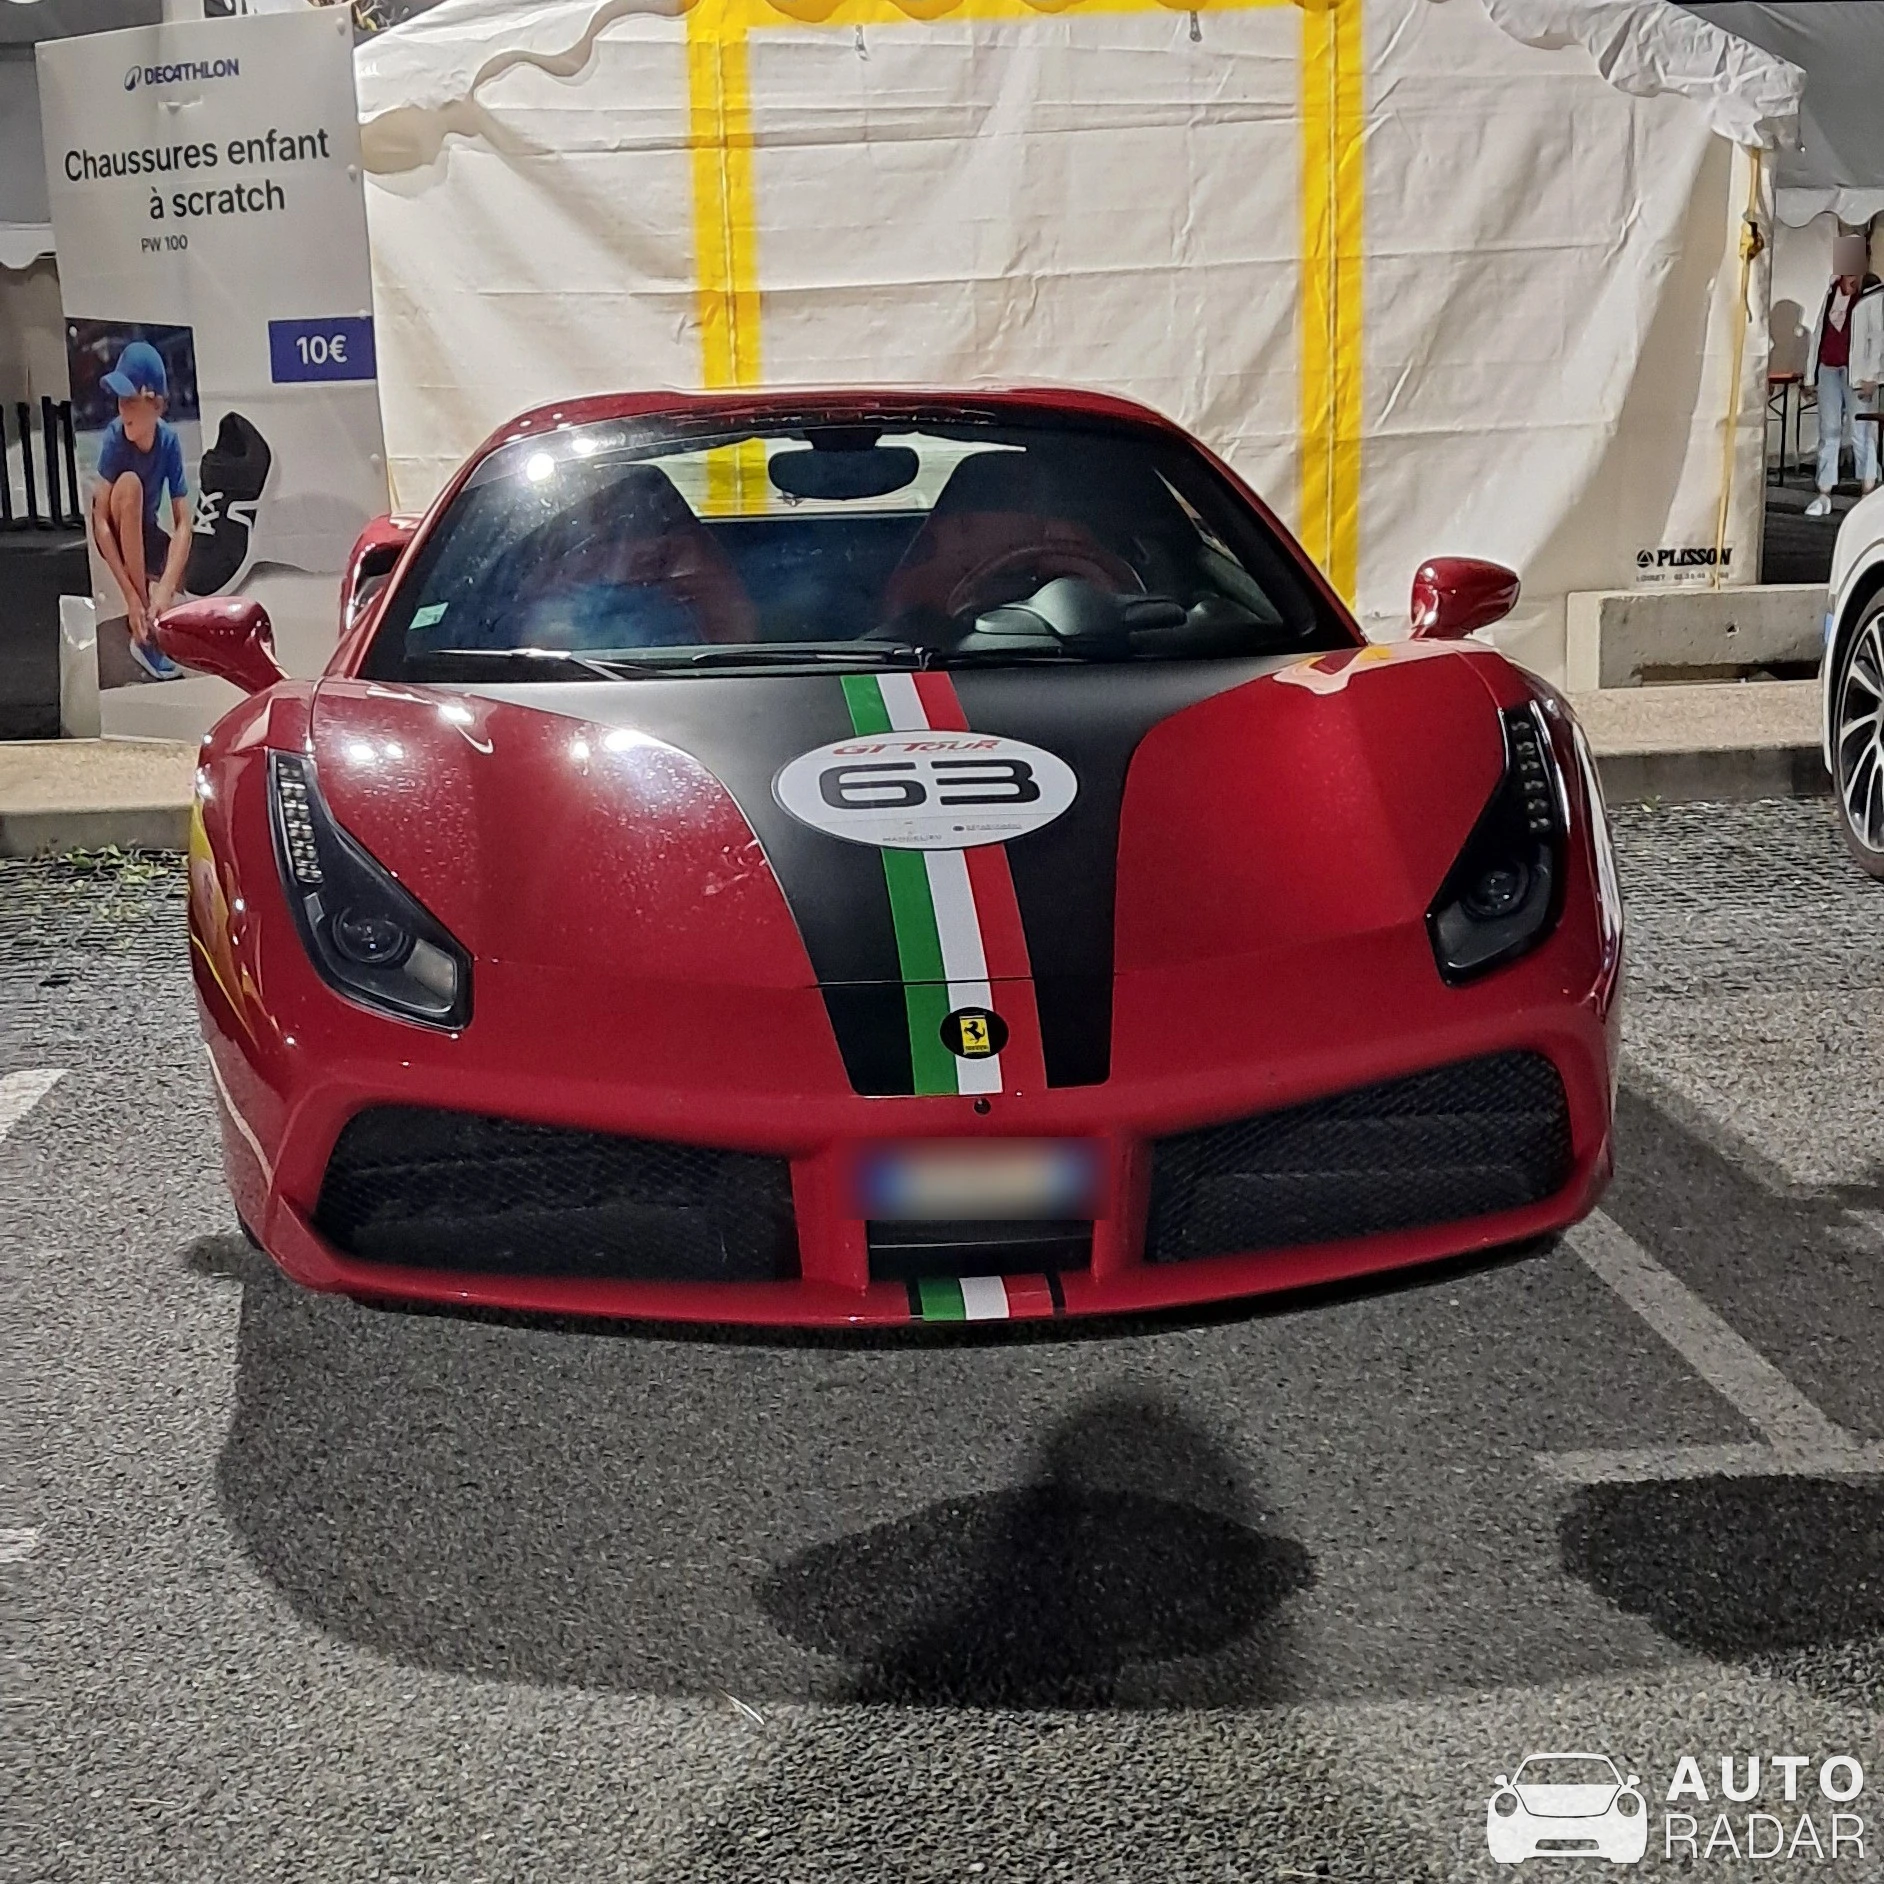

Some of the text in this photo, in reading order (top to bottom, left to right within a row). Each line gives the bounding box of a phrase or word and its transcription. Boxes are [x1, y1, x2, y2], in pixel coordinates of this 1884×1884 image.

[144, 58, 240, 86] DECATHLON
[64, 128, 331, 183] Chaussures enfant
[149, 179, 286, 220] à scratch
[140, 233, 189, 254] PW 100
[295, 334, 349, 366] 10€
[1656, 547, 1734, 568] PLISSON
[832, 739, 1002, 756] GT TOUR
[818, 758, 1042, 811] 63
